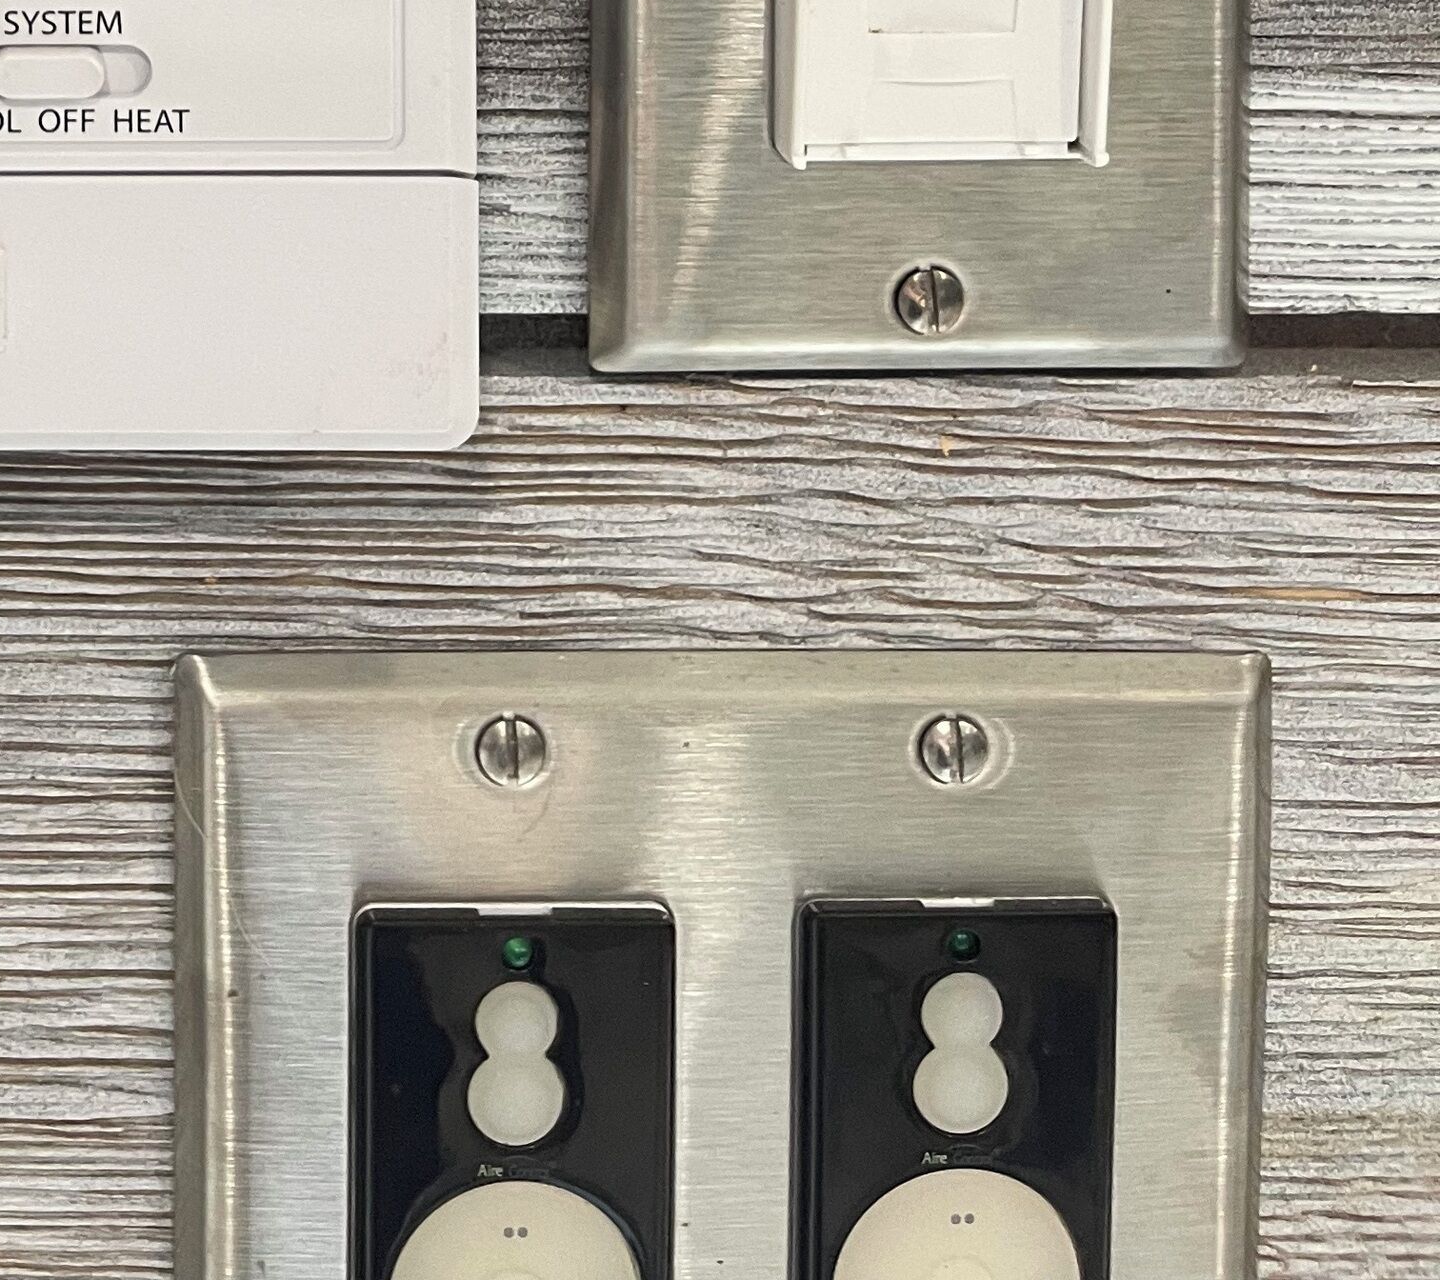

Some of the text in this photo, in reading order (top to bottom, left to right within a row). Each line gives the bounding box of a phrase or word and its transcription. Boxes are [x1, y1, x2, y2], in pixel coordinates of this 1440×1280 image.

[3, 10, 123, 36] SYSTEM
[37, 109, 96, 135] OFF
[113, 108, 190, 134] HEAT
